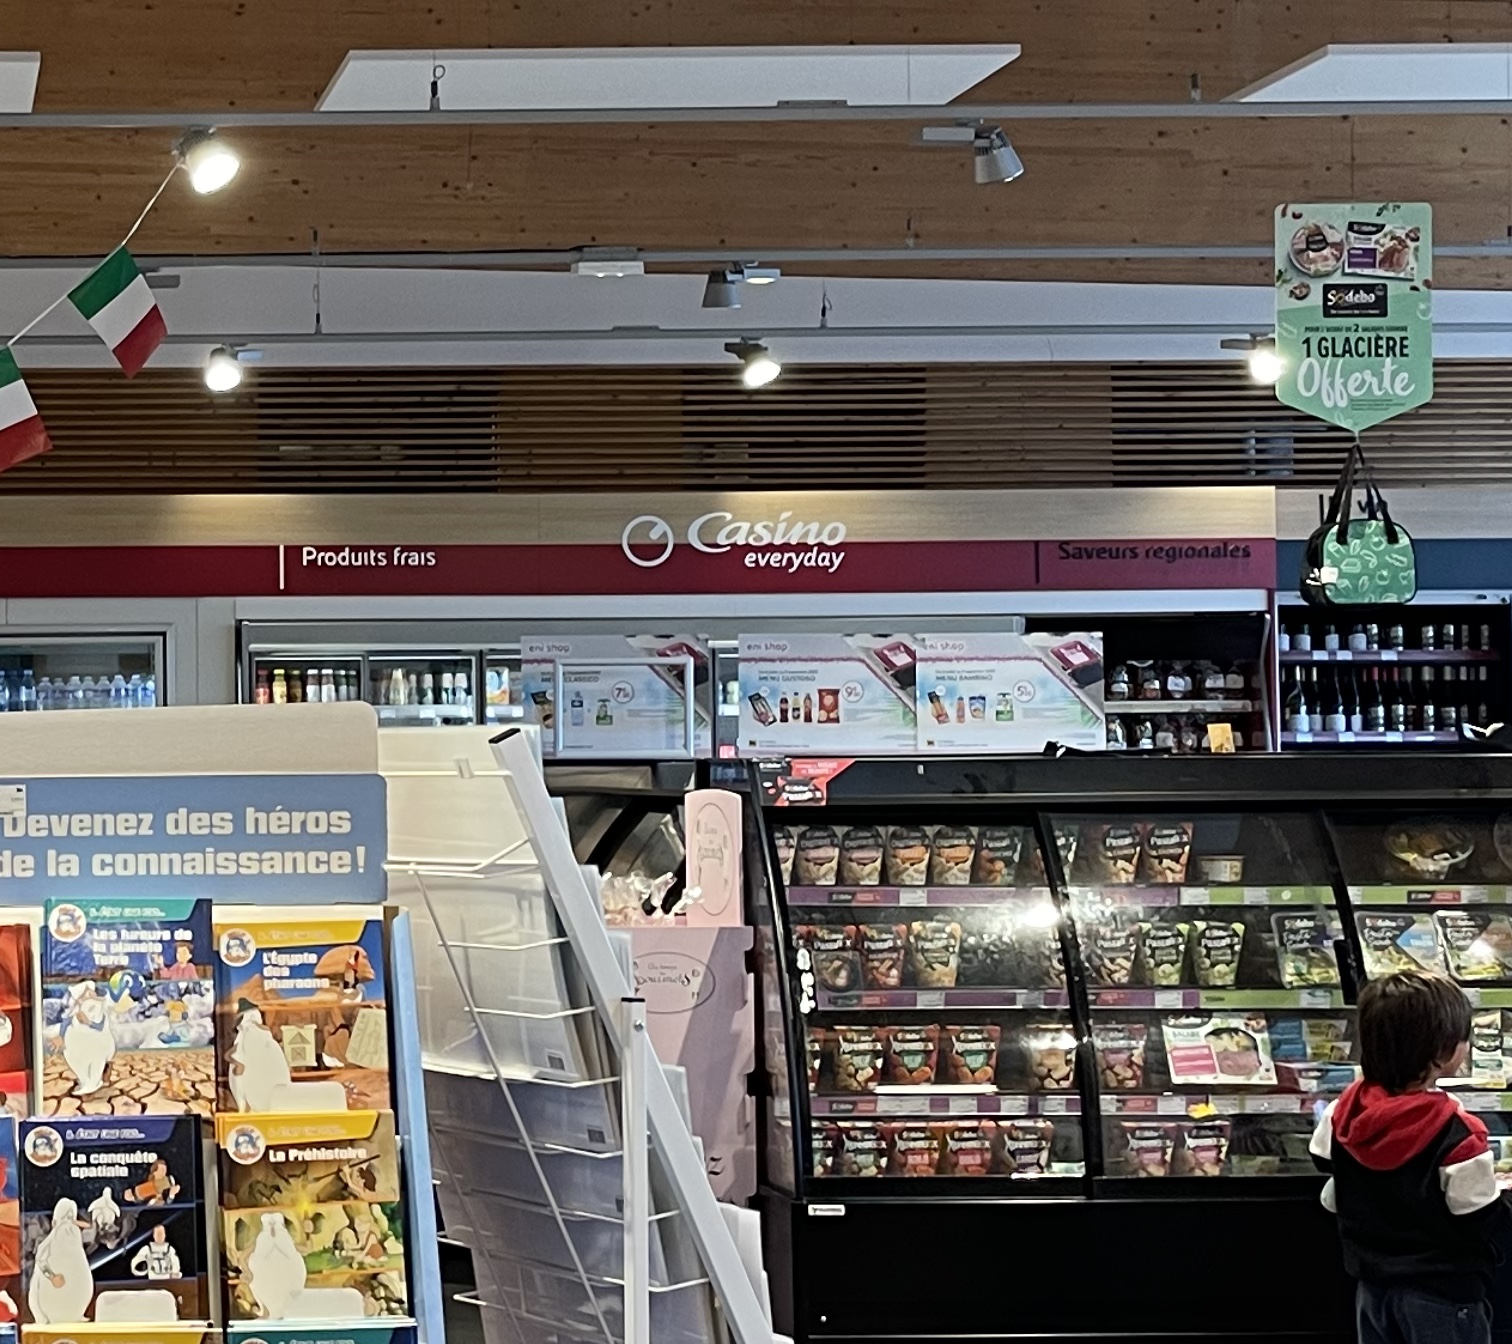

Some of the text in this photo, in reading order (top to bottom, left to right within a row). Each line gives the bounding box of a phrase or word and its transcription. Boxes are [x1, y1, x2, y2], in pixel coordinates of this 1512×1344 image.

[1302, 332, 1409, 358] 1 GLACIÈRE
[1297, 358, 1416, 407] Offerte
[687, 512, 847, 553] Casino
[301, 547, 437, 567] Produits frais
[744, 546, 845, 572] everyday
[1058, 541, 1139, 560] Saveurs
[3, 805, 352, 838] Devenez des héros
[47, 849, 81, 878] la
[174, 928, 193, 941] de
[70, 1150, 157, 1165] La conquête
[268, 1146, 367, 1162] La Préhistoire
